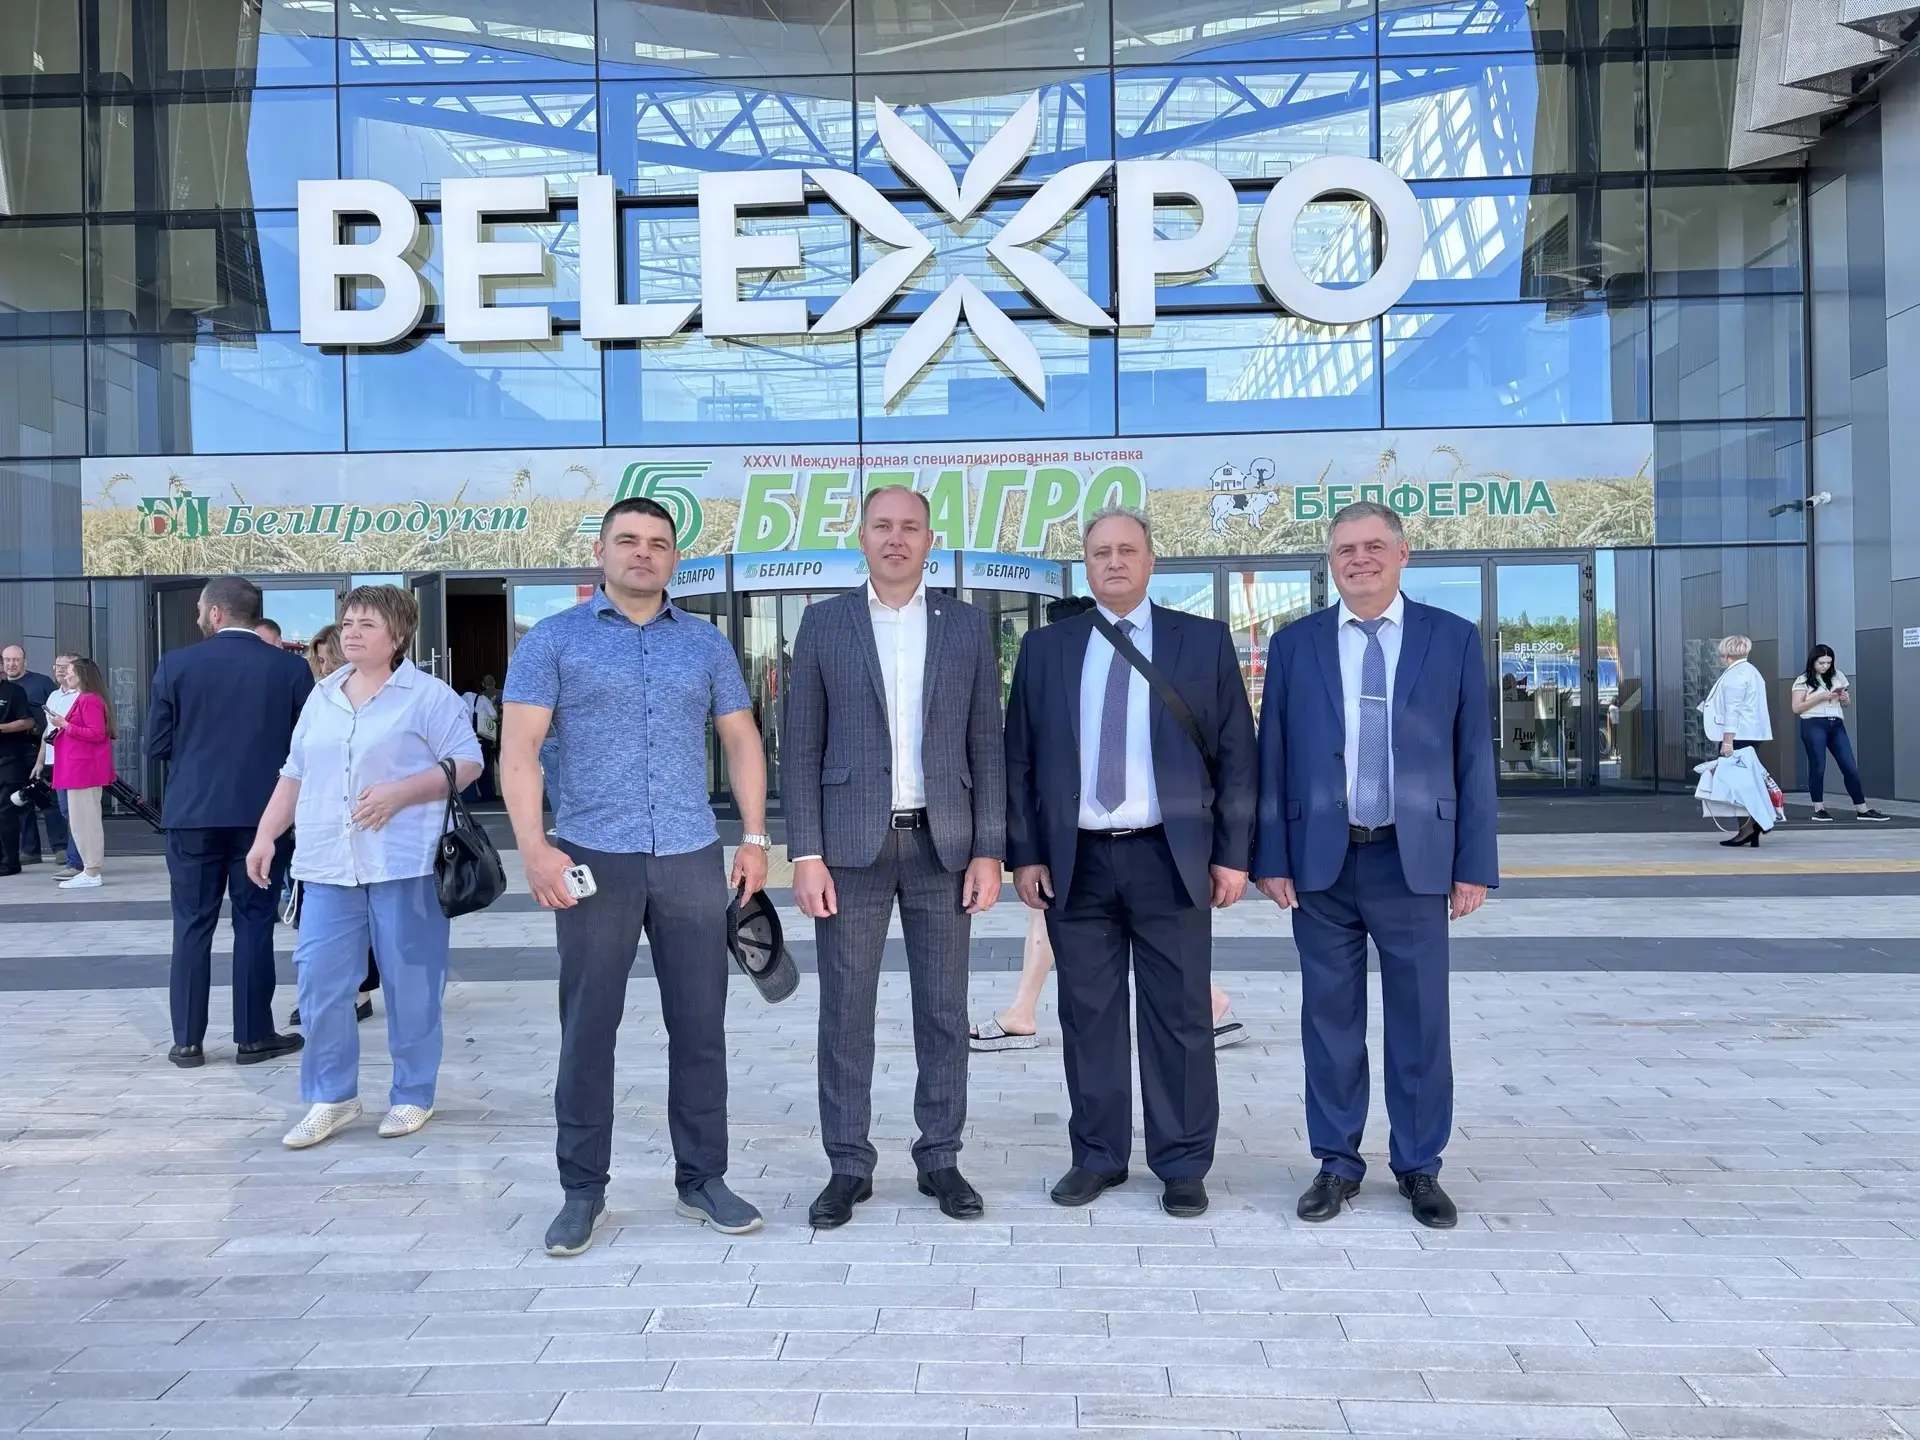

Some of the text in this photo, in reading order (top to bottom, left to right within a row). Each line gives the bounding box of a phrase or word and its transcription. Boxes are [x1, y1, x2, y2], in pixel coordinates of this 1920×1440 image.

[298, 94, 1423, 410] BELEXPO
[743, 448, 1144, 469] XXXVI Международная специализированная выставка
[221, 499, 529, 544] БелПродукт
[677, 567, 715, 586] БЕЛАГРО
[759, 561, 823, 578] БЕЛАГРО
[986, 563, 1031, 580] БЕЛАГРО
[1514, 640, 1564, 653] BELEXPO
